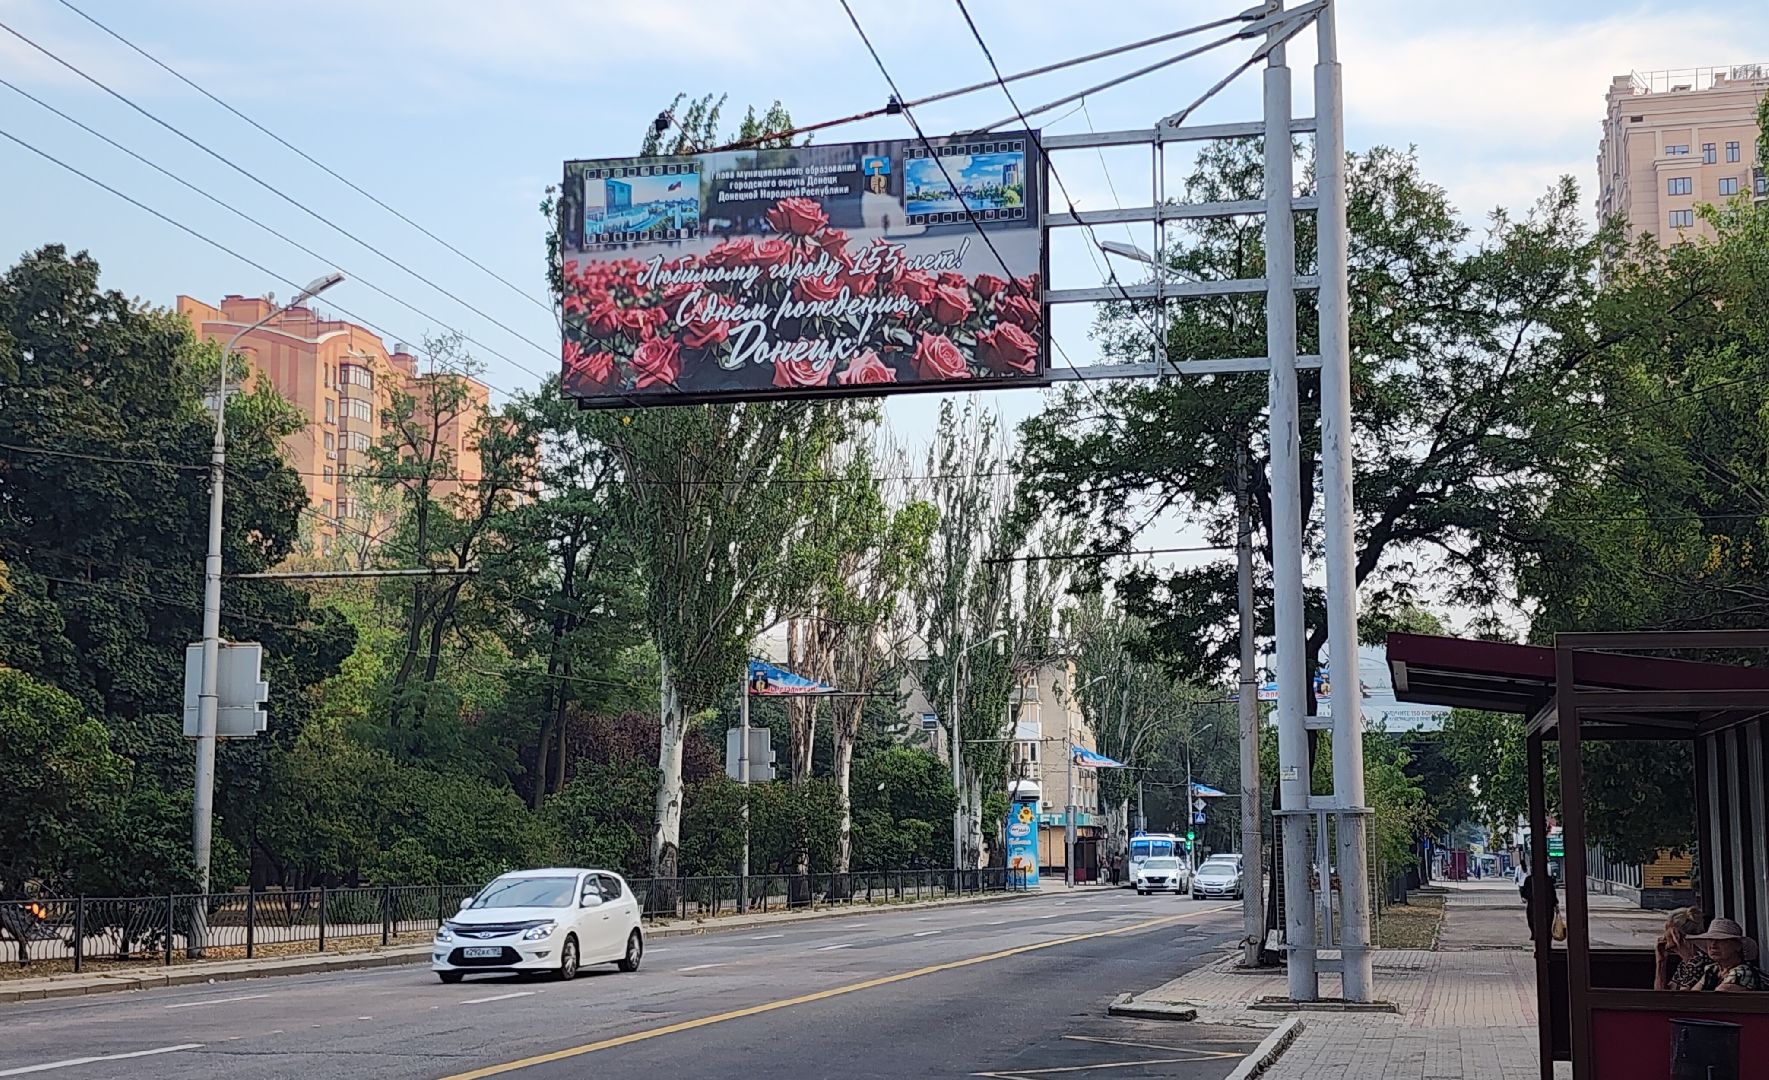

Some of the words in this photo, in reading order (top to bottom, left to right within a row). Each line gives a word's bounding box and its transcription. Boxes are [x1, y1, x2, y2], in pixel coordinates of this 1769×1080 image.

[711, 169, 735, 180] Глава
[736, 166, 804, 179] муниципального
[805, 164, 857, 174] образования
[729, 179, 777, 190] городского
[778, 177, 805, 188] округа
[807, 175, 838, 186] Донецк
[718, 188, 758, 202] Донецкой
[760, 187, 800, 200] Народной
[801, 185, 850, 197] Республики
[636, 254, 764, 290] Любимому
[768, 251, 845, 286] городу
[849, 244, 906, 275] 155
[906, 236, 971, 271] лет!
[675, 288, 703, 327] С
[701, 292, 770, 324] днём
[773, 285, 920, 331] рождения,
[724, 312, 874, 371] Донецк!
